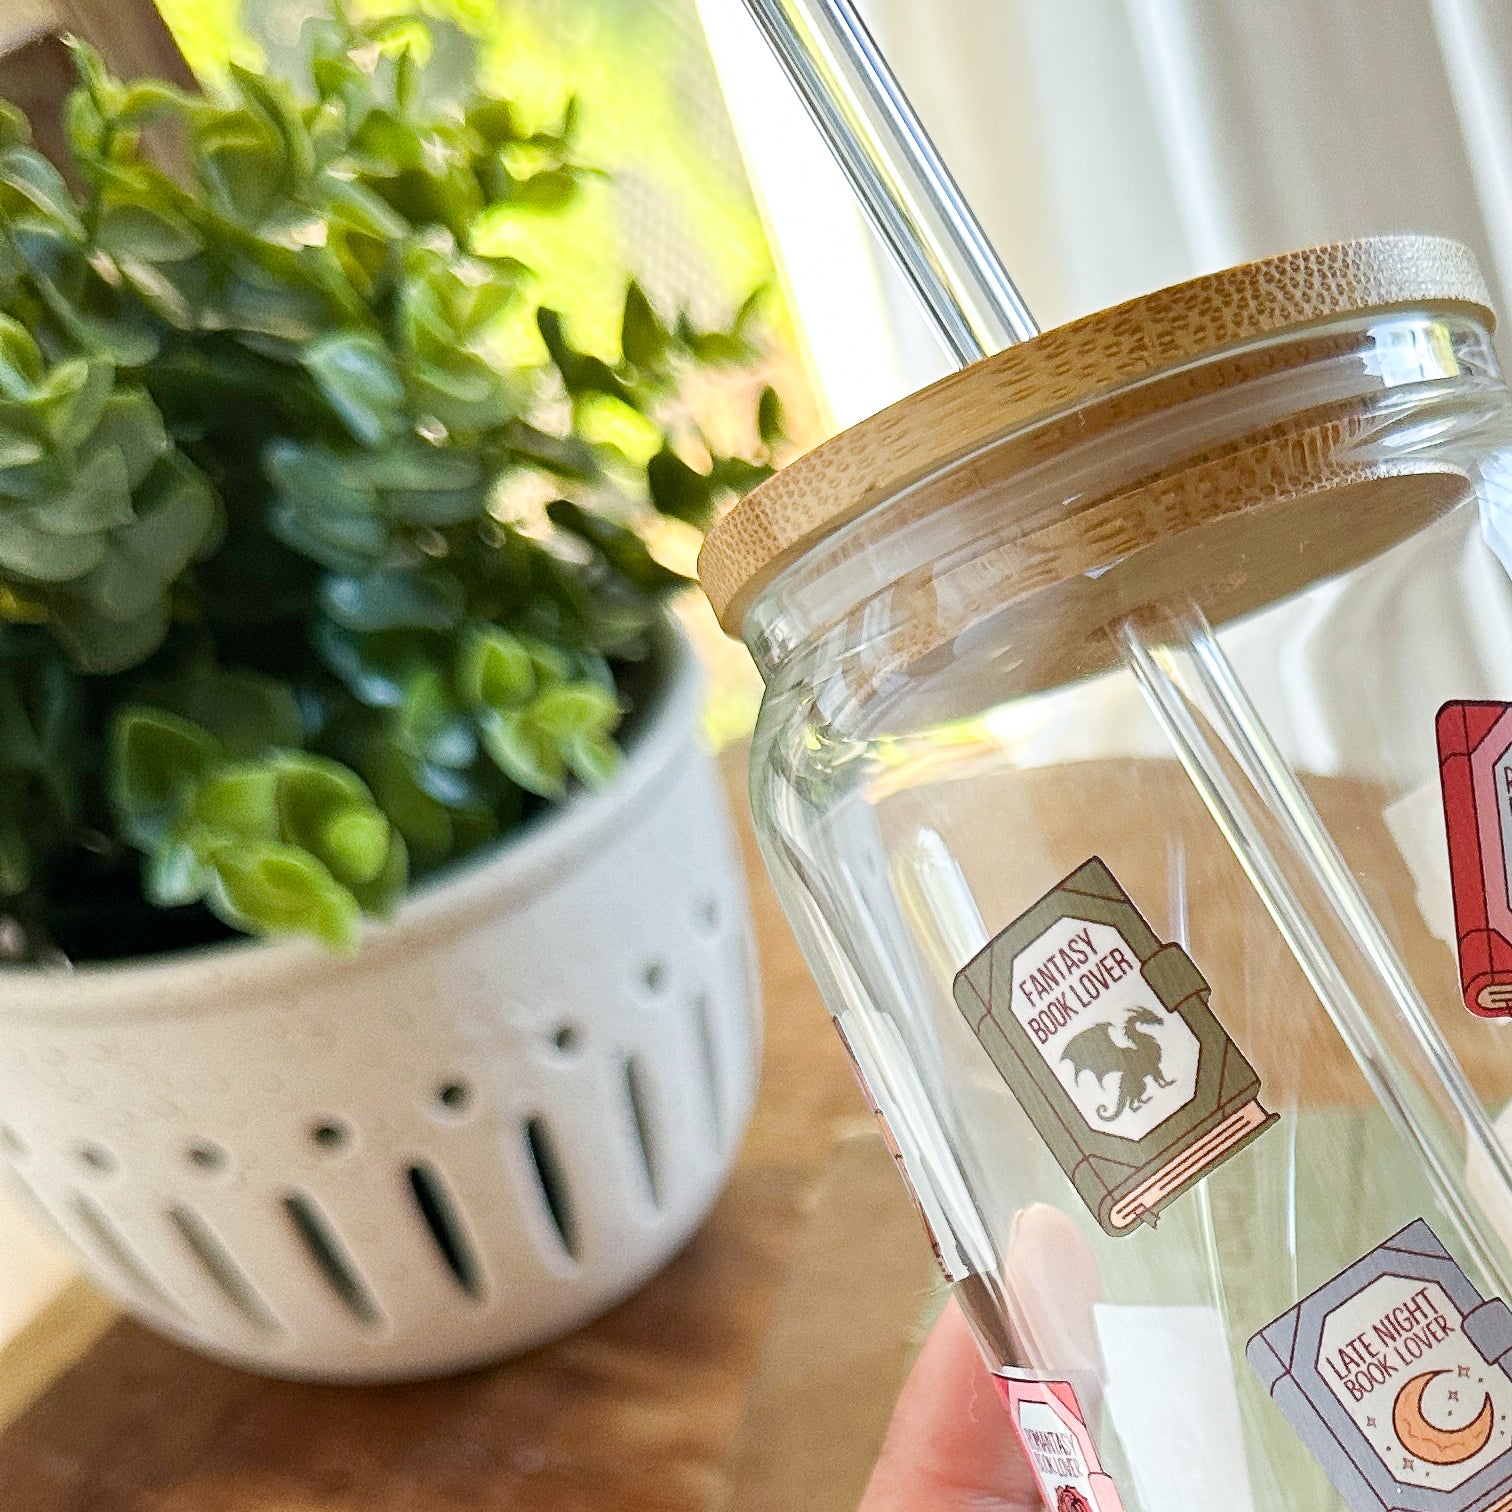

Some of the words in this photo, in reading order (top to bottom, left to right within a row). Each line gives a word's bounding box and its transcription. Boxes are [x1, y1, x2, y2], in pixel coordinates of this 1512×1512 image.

[1019, 927, 1098, 1008] FANTASY
[1027, 991, 1080, 1045] BOOK
[1069, 947, 1134, 1009] LOVER
[1325, 1331, 1381, 1381] LATE
[1371, 1286, 1439, 1348] NIGHT
[1343, 1353, 1399, 1403] BOOK
[1393, 1313, 1457, 1367] LOVER
